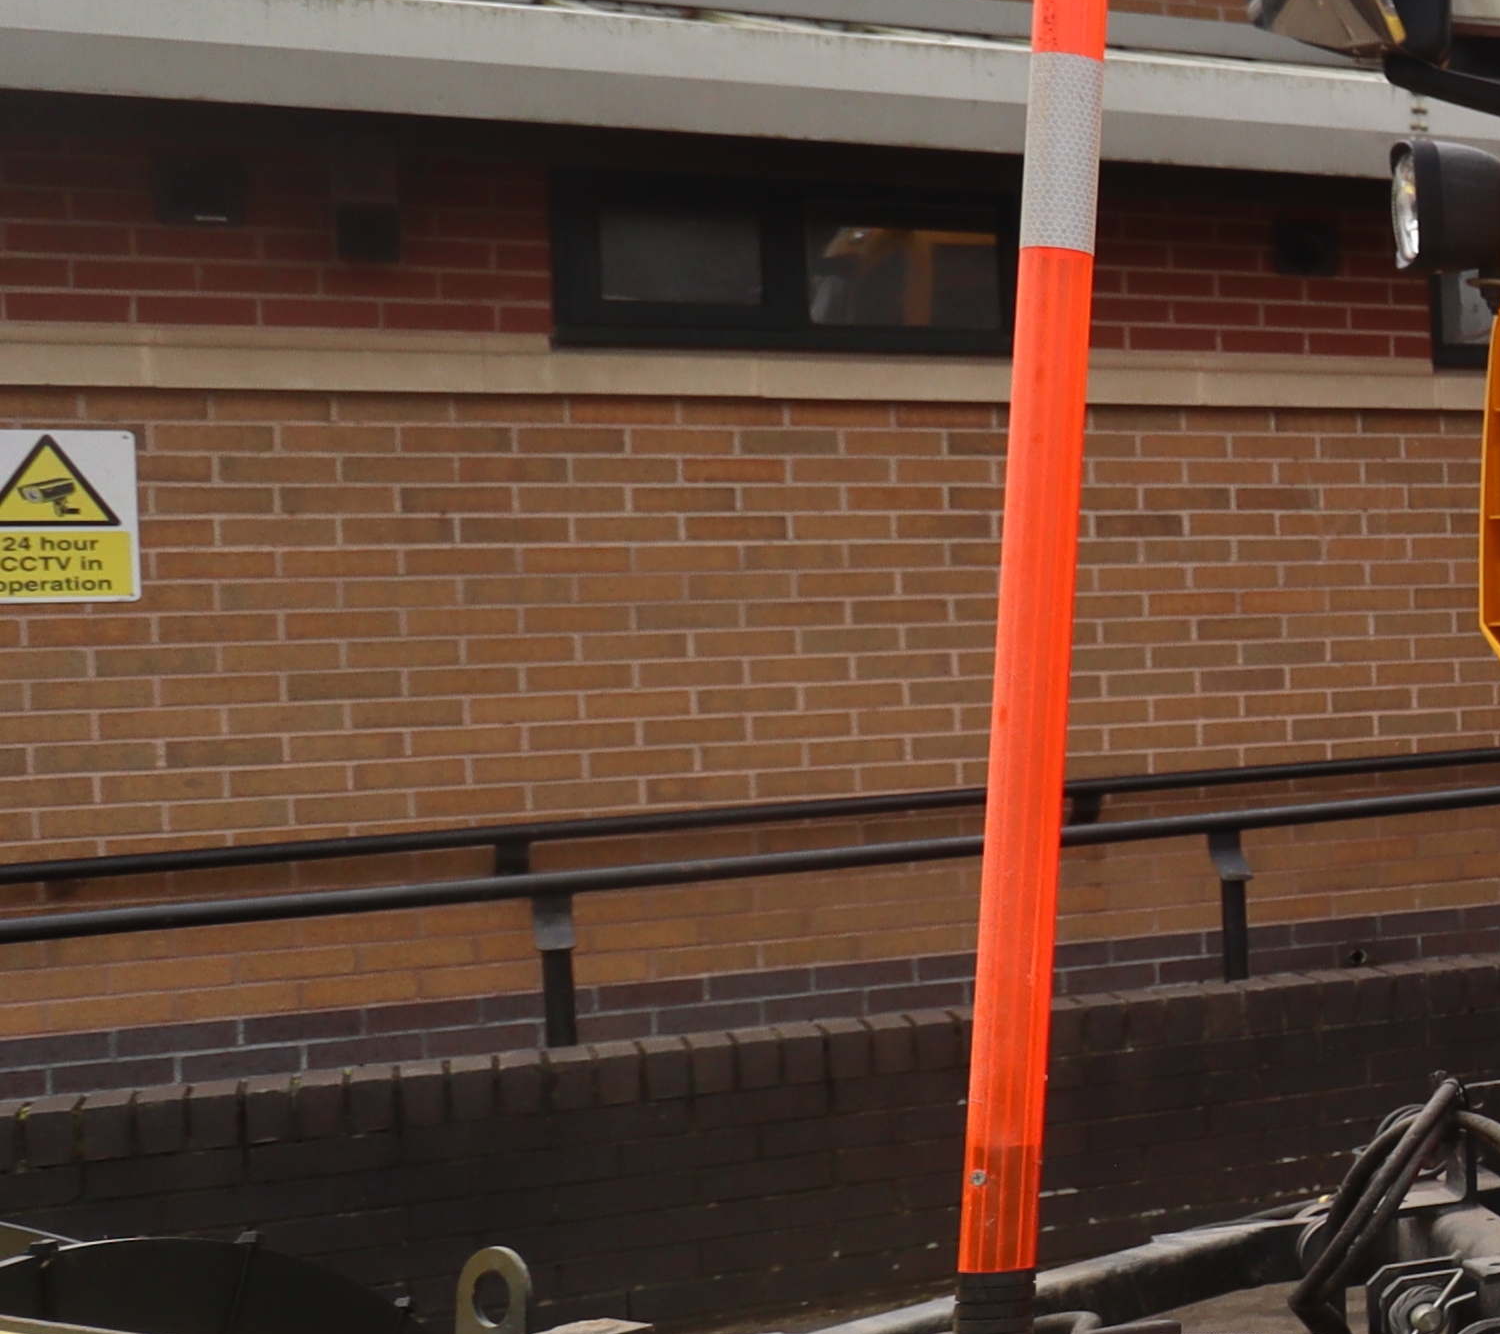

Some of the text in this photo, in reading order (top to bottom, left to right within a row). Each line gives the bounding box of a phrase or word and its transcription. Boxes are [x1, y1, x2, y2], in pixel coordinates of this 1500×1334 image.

[2, 535, 99, 552] 24 hour
[0, 555, 103, 573] CCTV in
